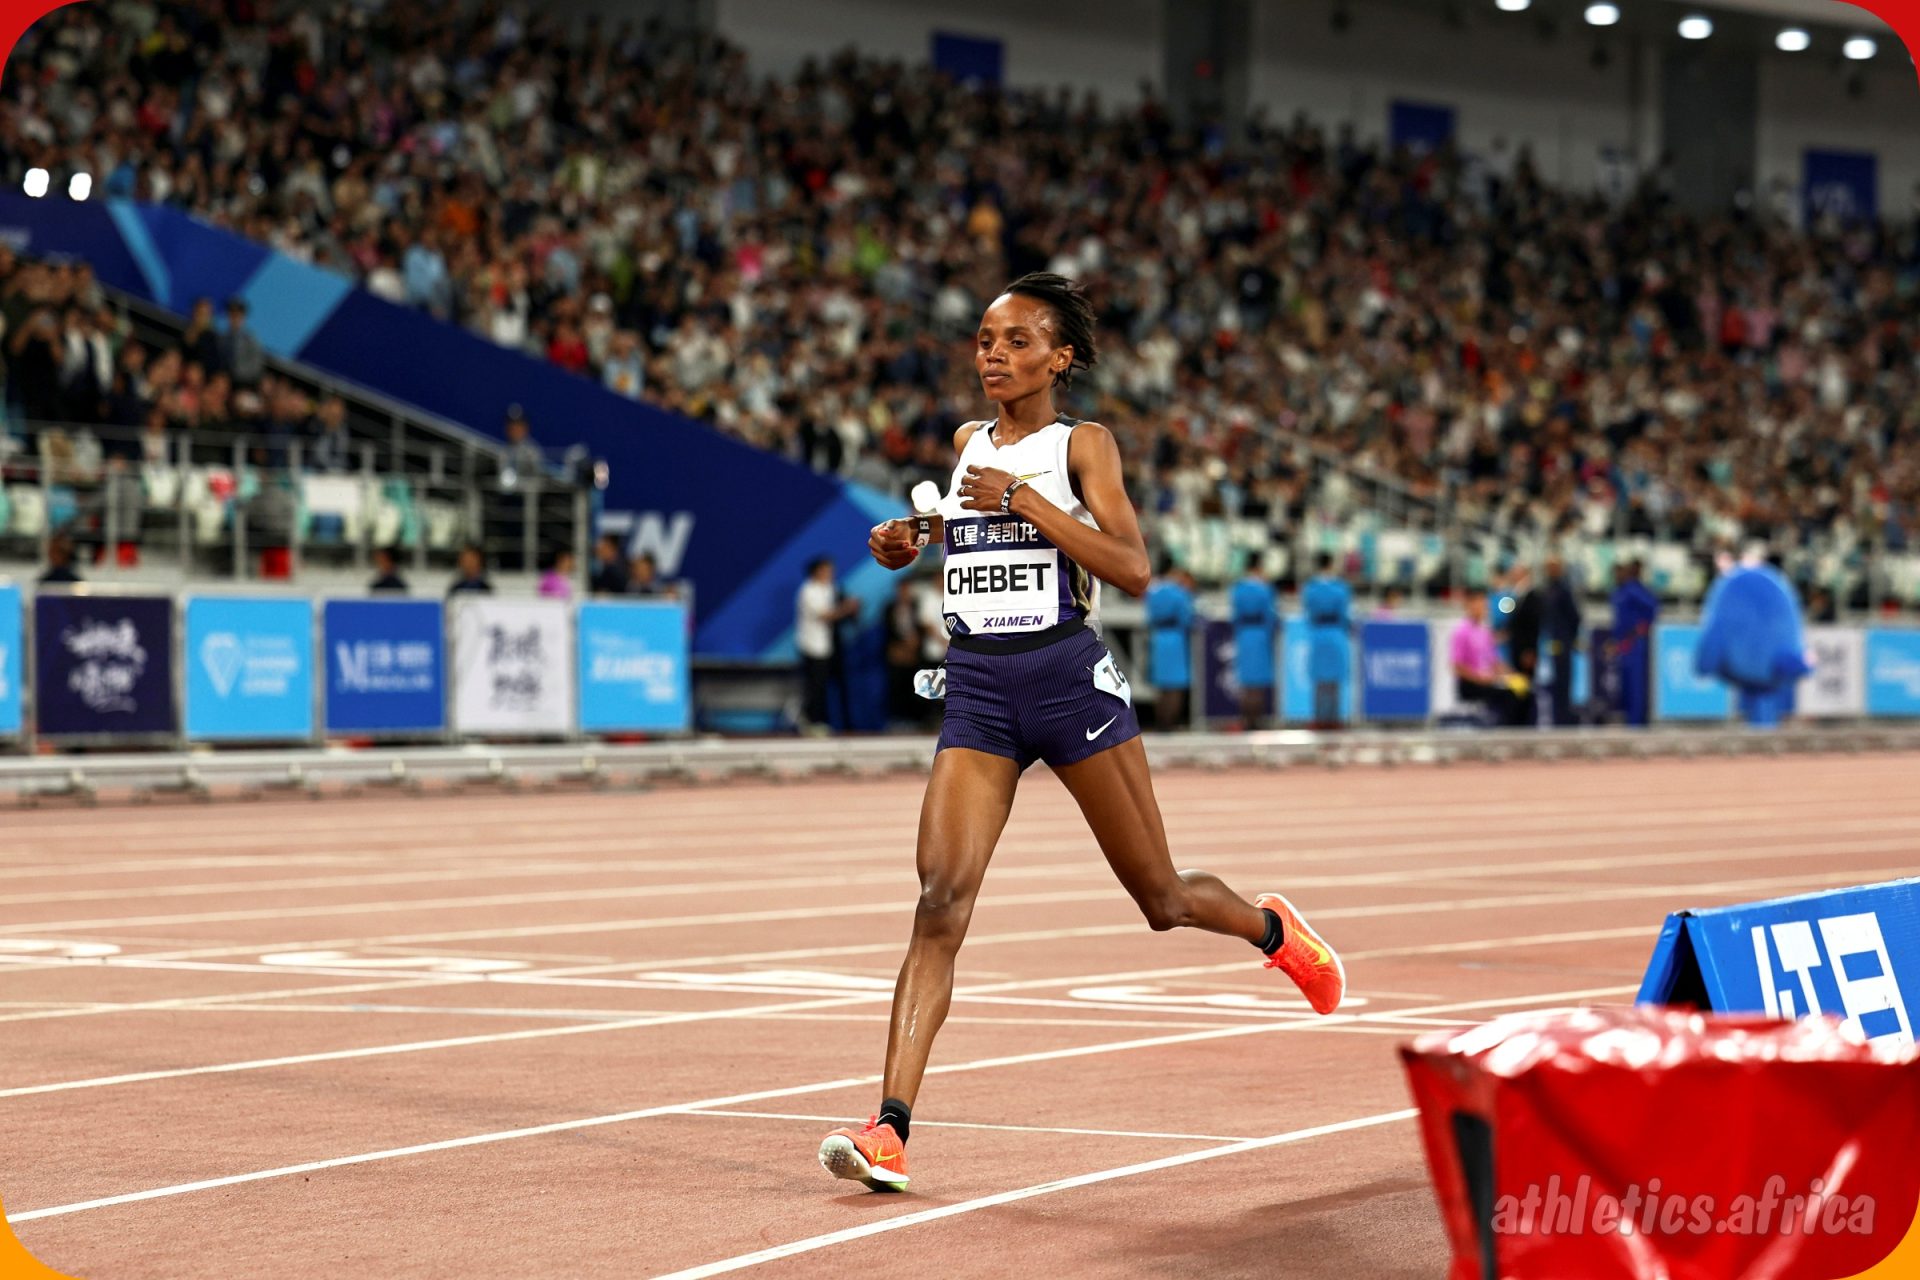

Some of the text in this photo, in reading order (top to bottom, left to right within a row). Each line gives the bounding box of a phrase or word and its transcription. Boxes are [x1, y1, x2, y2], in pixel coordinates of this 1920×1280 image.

[953, 521, 1039, 547] 红星·美凯龙
[947, 563, 1052, 595] CHEBET
[983, 615, 1044, 628] XIAMEN
